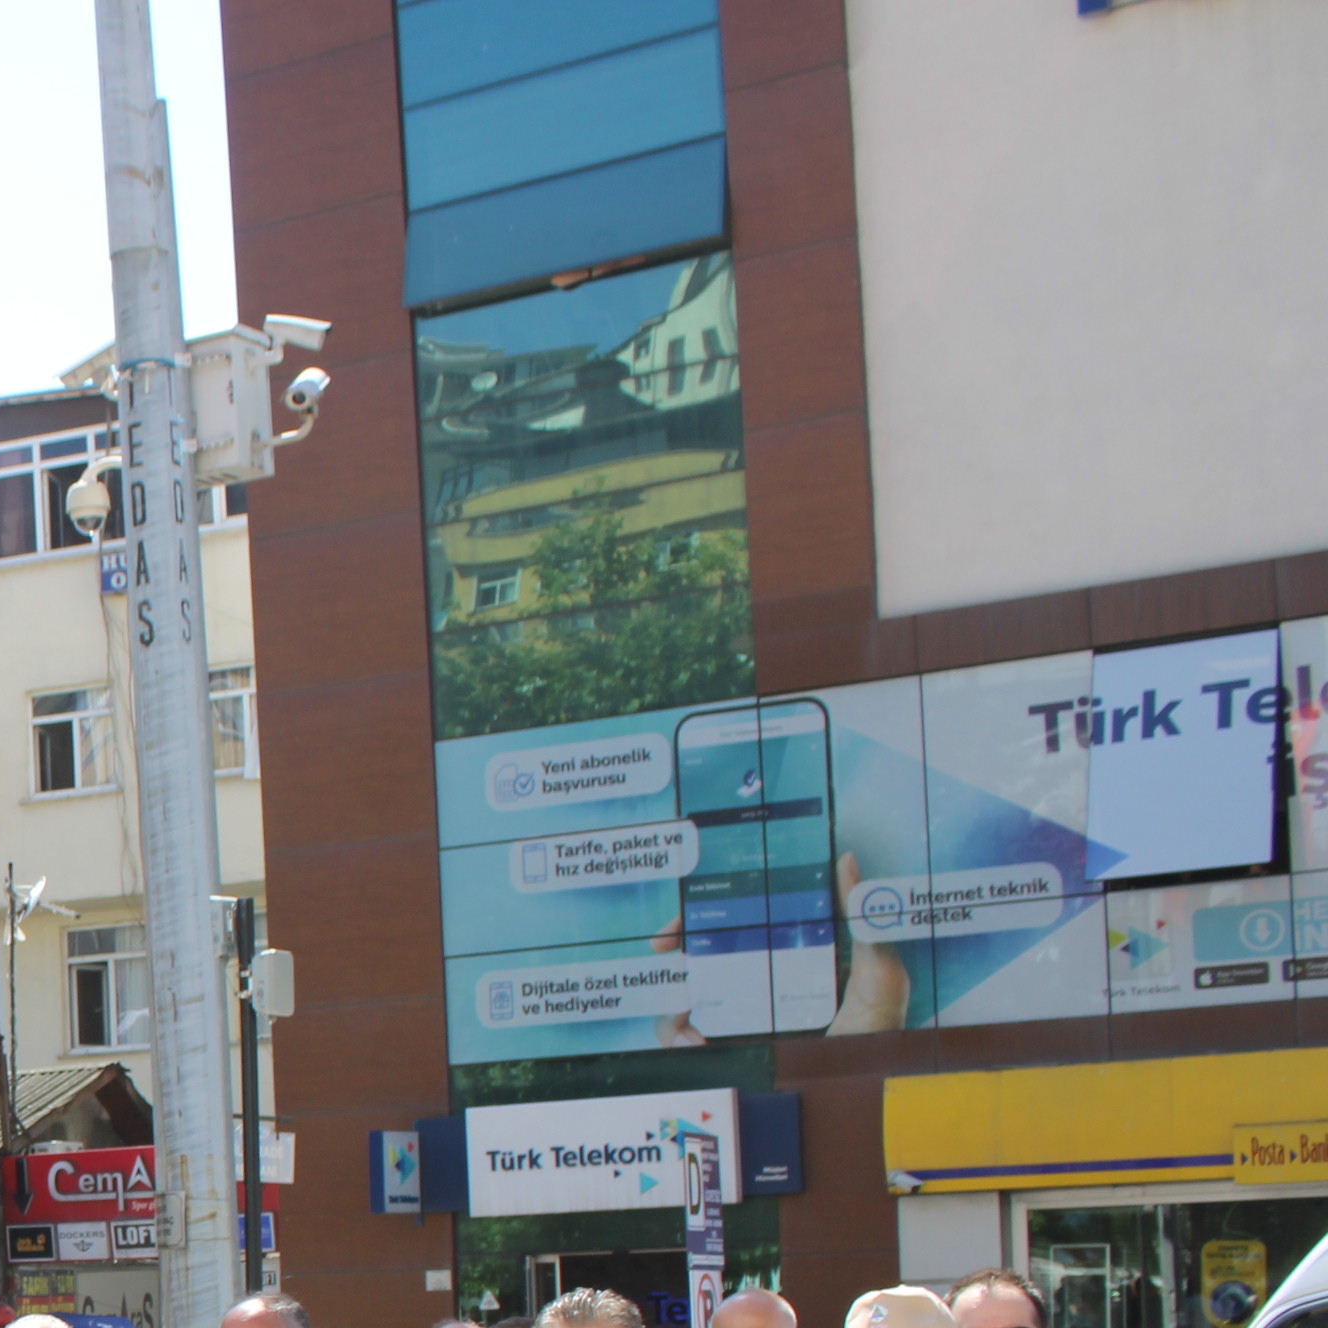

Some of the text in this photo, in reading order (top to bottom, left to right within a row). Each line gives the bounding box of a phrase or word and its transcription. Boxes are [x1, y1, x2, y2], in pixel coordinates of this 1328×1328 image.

[1027, 688, 1185, 754] Türk
[541, 748, 652, 775] Yeni abonelik
[542, 772, 627, 795] başvurusu
[554, 832, 683, 859] Tarife, paket ve
[555, 850, 670, 877] hız değişikliği
[910, 877, 1050, 907] İnternet teknik
[910, 906, 974, 926] destek
[521, 968, 690, 999] Dijitale özel teklifler
[522, 995, 623, 1015] ve hediyeler
[486, 1142, 663, 1173] Türk Telekom
[1250, 1135, 1286, 1168] Posta
[58, 1229, 107, 1240] DOCKERS
